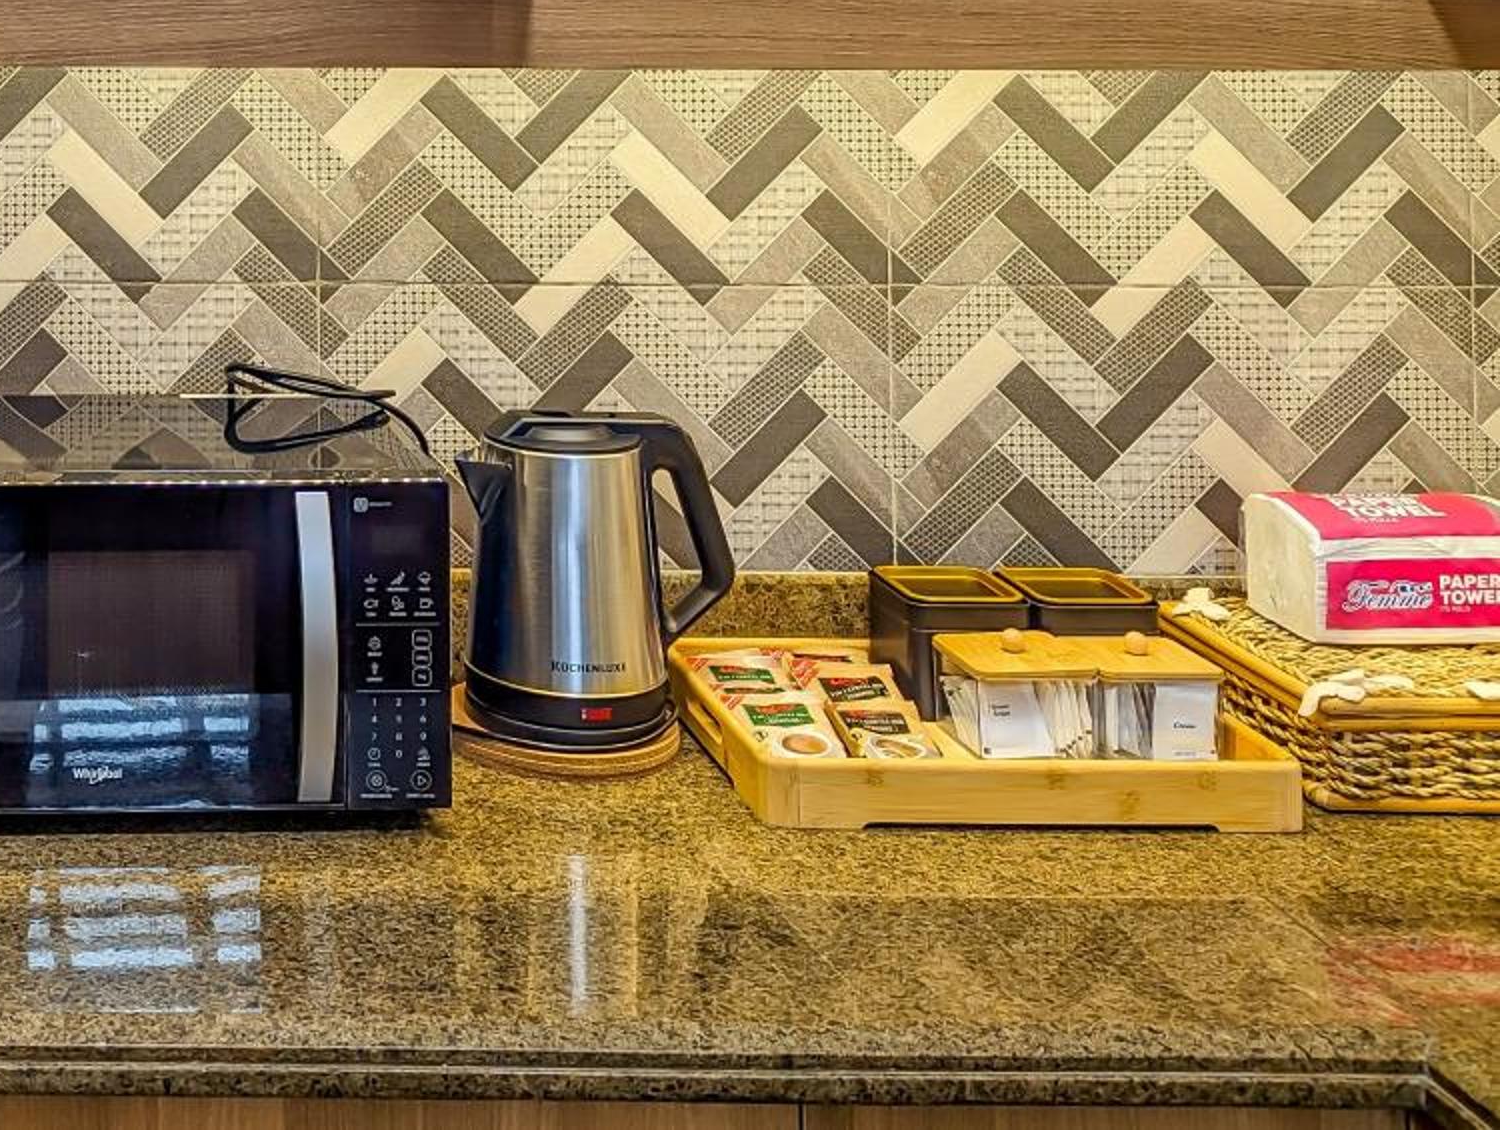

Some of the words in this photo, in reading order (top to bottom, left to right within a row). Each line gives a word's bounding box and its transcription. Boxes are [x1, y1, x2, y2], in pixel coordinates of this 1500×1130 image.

[1338, 505, 1448, 518] TOWEL
[1440, 574, 1500, 589] PAPER
[72, 765, 123, 785] Whirlpool
